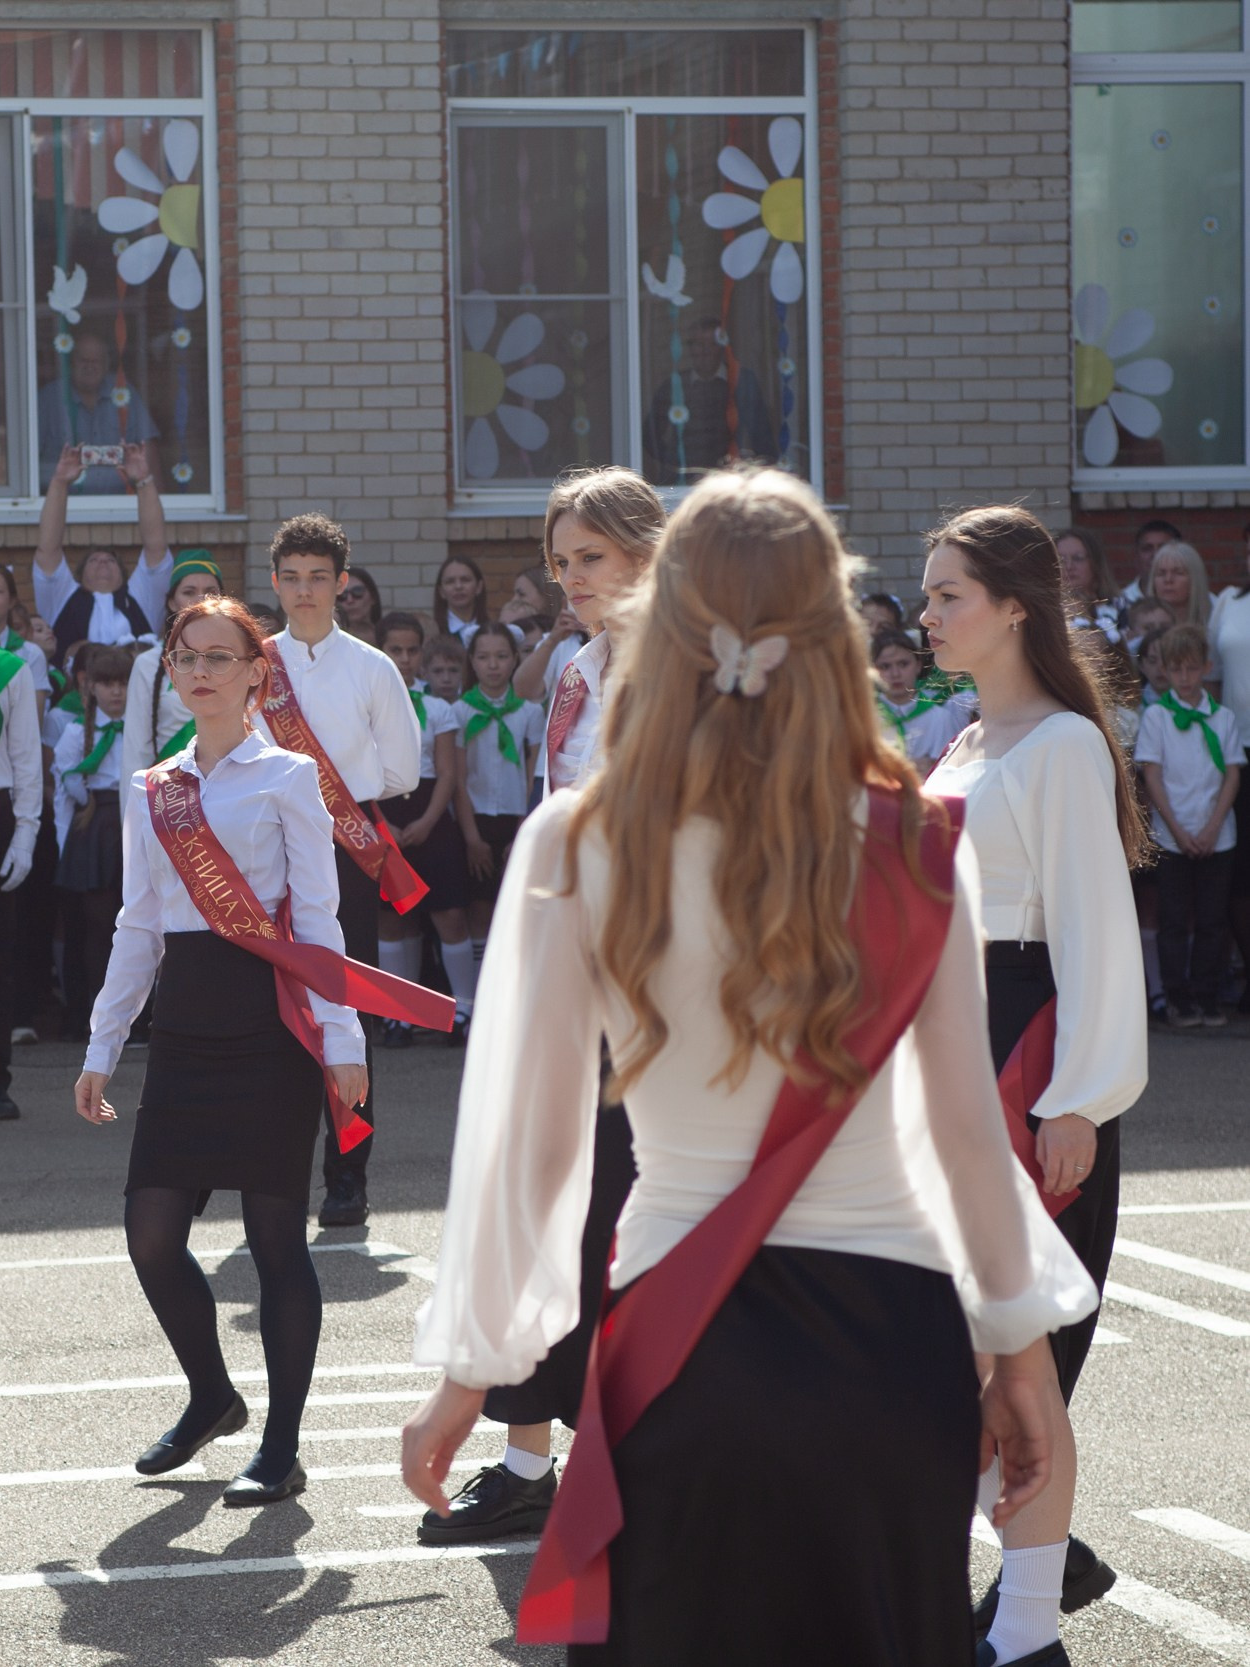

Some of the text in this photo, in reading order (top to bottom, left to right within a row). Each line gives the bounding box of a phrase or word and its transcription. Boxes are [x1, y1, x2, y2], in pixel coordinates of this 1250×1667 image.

[188, 804, 206, 834] Дарья
[276, 708, 342, 809] ВЫПУНИК
[336, 811, 371, 850] 2025
[164, 781, 239, 918] ВЫПУСКНИЦА
[170, 838, 191, 872] МАОУ
[187, 873, 206, 900] СОШ
[200, 897, 220, 920] №10
